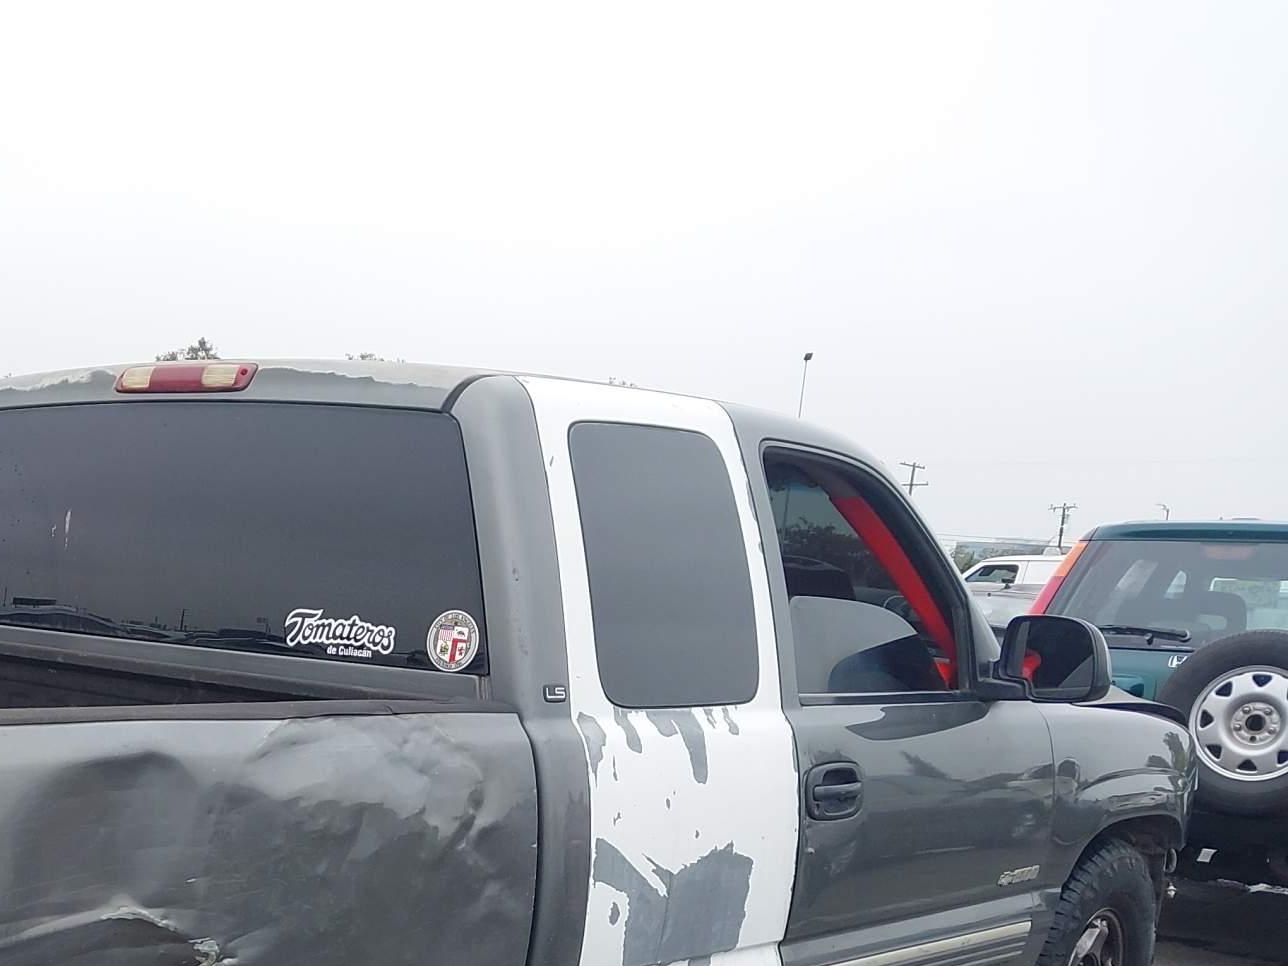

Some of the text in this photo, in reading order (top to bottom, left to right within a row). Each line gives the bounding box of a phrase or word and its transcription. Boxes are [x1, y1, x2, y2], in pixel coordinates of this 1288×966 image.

[285, 608, 396, 655] Tomateros
[326, 645, 337, 655] de
[545, 687, 566, 699] LS
